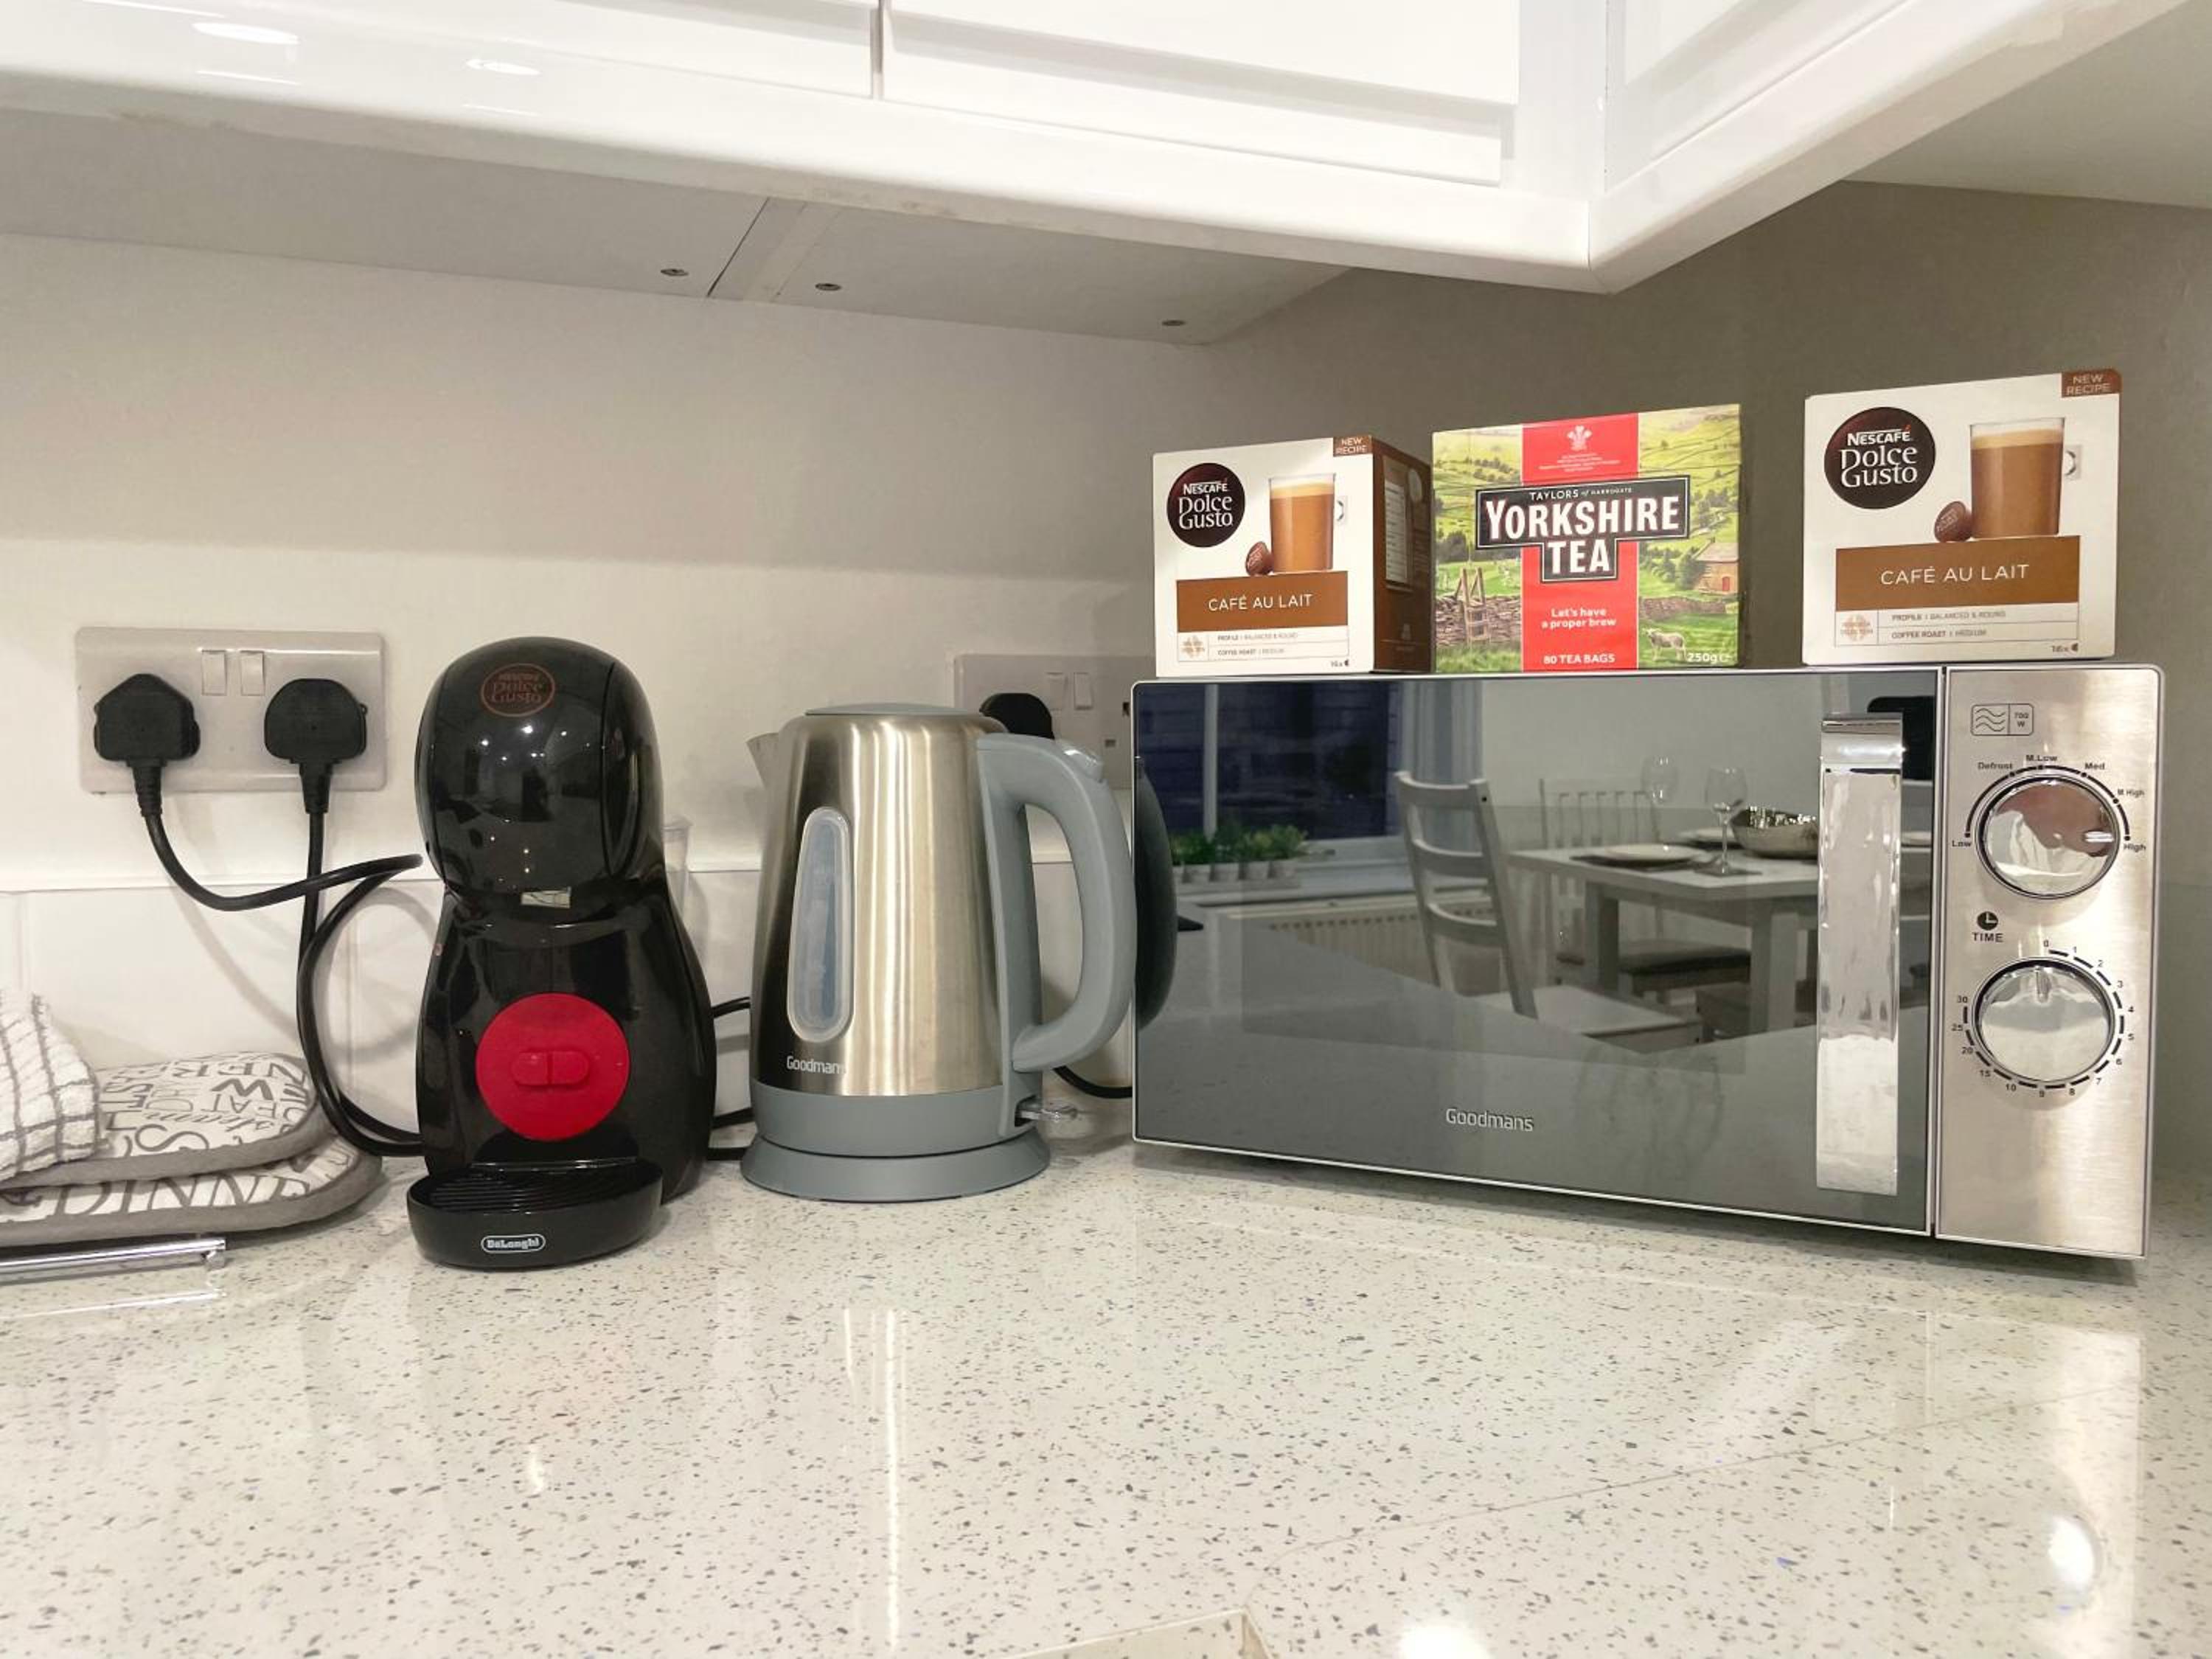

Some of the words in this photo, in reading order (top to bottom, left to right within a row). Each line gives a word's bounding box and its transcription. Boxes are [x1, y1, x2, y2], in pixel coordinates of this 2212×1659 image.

[1840, 445, 1918, 469] Dolce
[1841, 464, 1917, 487] Gusto
[1529, 489, 1579, 501] TAYLORS
[1179, 494, 1233, 514] Dolce
[1179, 511, 1234, 529] Gusto
[1486, 495, 1680, 540] YORKSHIRE
[1548, 539, 1610, 574] TEA
[1881, 565, 1935, 585] CAFÉ
[1944, 566, 1973, 581] AU
[1981, 564, 2030, 580] LAIT
[1208, 595, 1248, 611] CAFÉ
[1253, 595, 1274, 609] AU
[1279, 594, 1314, 608] LAIT
[1580, 608, 1607, 616] have
[1550, 619, 1588, 630] proper
[1589, 616, 1617, 627] brew
[1543, 654, 1557, 664] 80
[1559, 653, 1582, 663] TEA
[1584, 653, 1616, 663] BAGS
[2017, 720, 2026, 728] W
[1977, 762, 2014, 771] Defrost
[2084, 762, 2107, 771] Med
[1972, 932, 2004, 943] TIME
[2117, 980, 2124, 989] 3
[2127, 1006, 2135, 1014] 4
[787, 1055, 847, 1074] Goodman
[2005, 1083, 2017, 1092] 10
[1446, 1108, 1534, 1132] Goodmans
